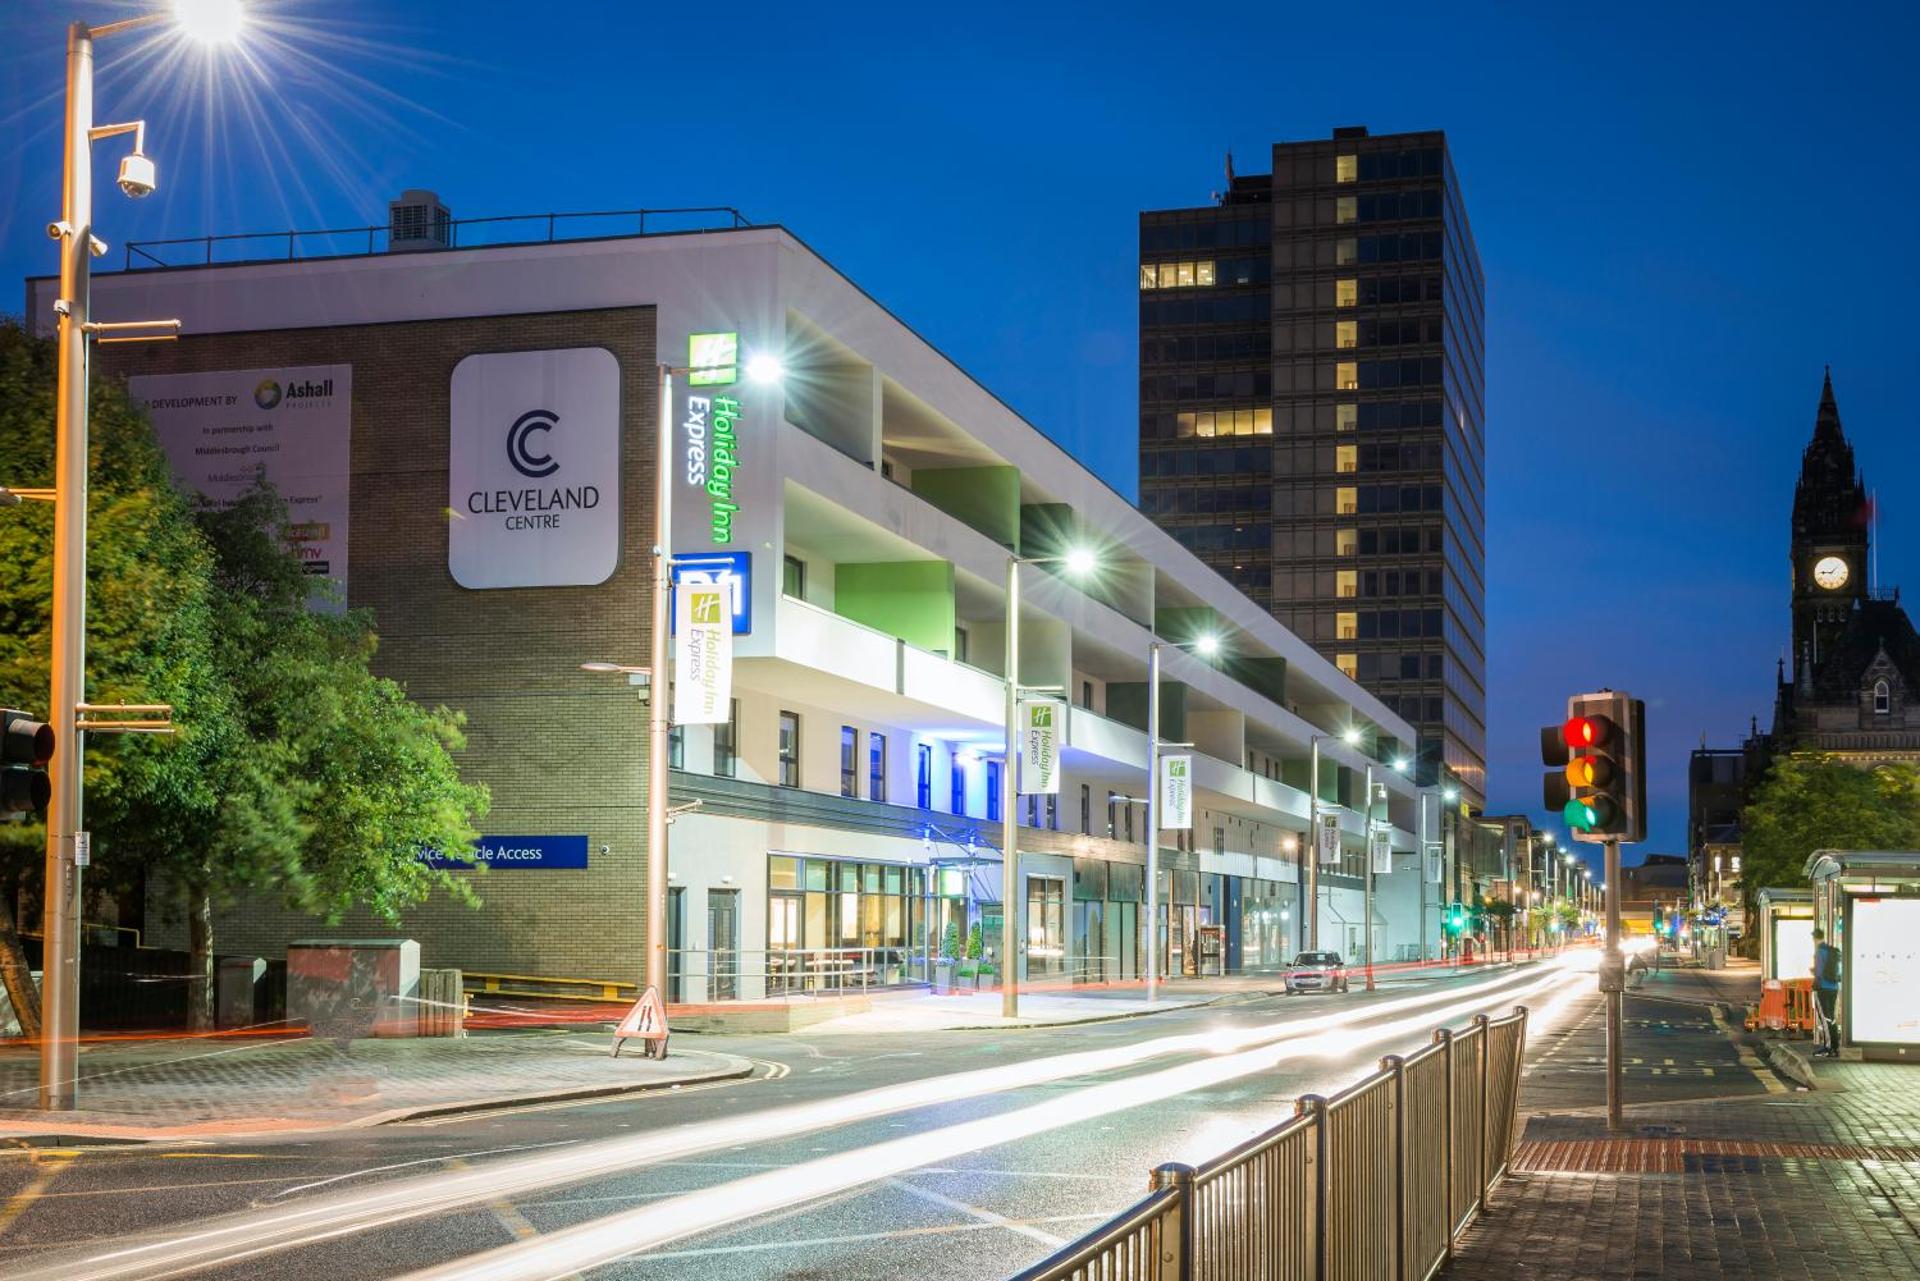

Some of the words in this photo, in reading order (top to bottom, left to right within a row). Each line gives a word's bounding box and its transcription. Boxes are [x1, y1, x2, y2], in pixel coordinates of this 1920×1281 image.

[152, 395, 222, 409] DEVELOPMENT
[225, 395, 237, 406] BY
[286, 378, 333, 399] Ashall
[682, 395, 711, 487] Express
[707, 396, 741, 499] Holiday
[468, 486, 599, 514] CLEVELAND
[505, 514, 560, 531] CENTRE
[711, 500, 740, 544] Inn
[687, 628, 704, 681] Express
[702, 628, 721, 690] Holiday
[704, 690, 717, 715] Inn
[1030, 730, 1041, 765] Express
[1039, 729, 1052, 770] Holiday
[496, 845, 543, 860] Access
